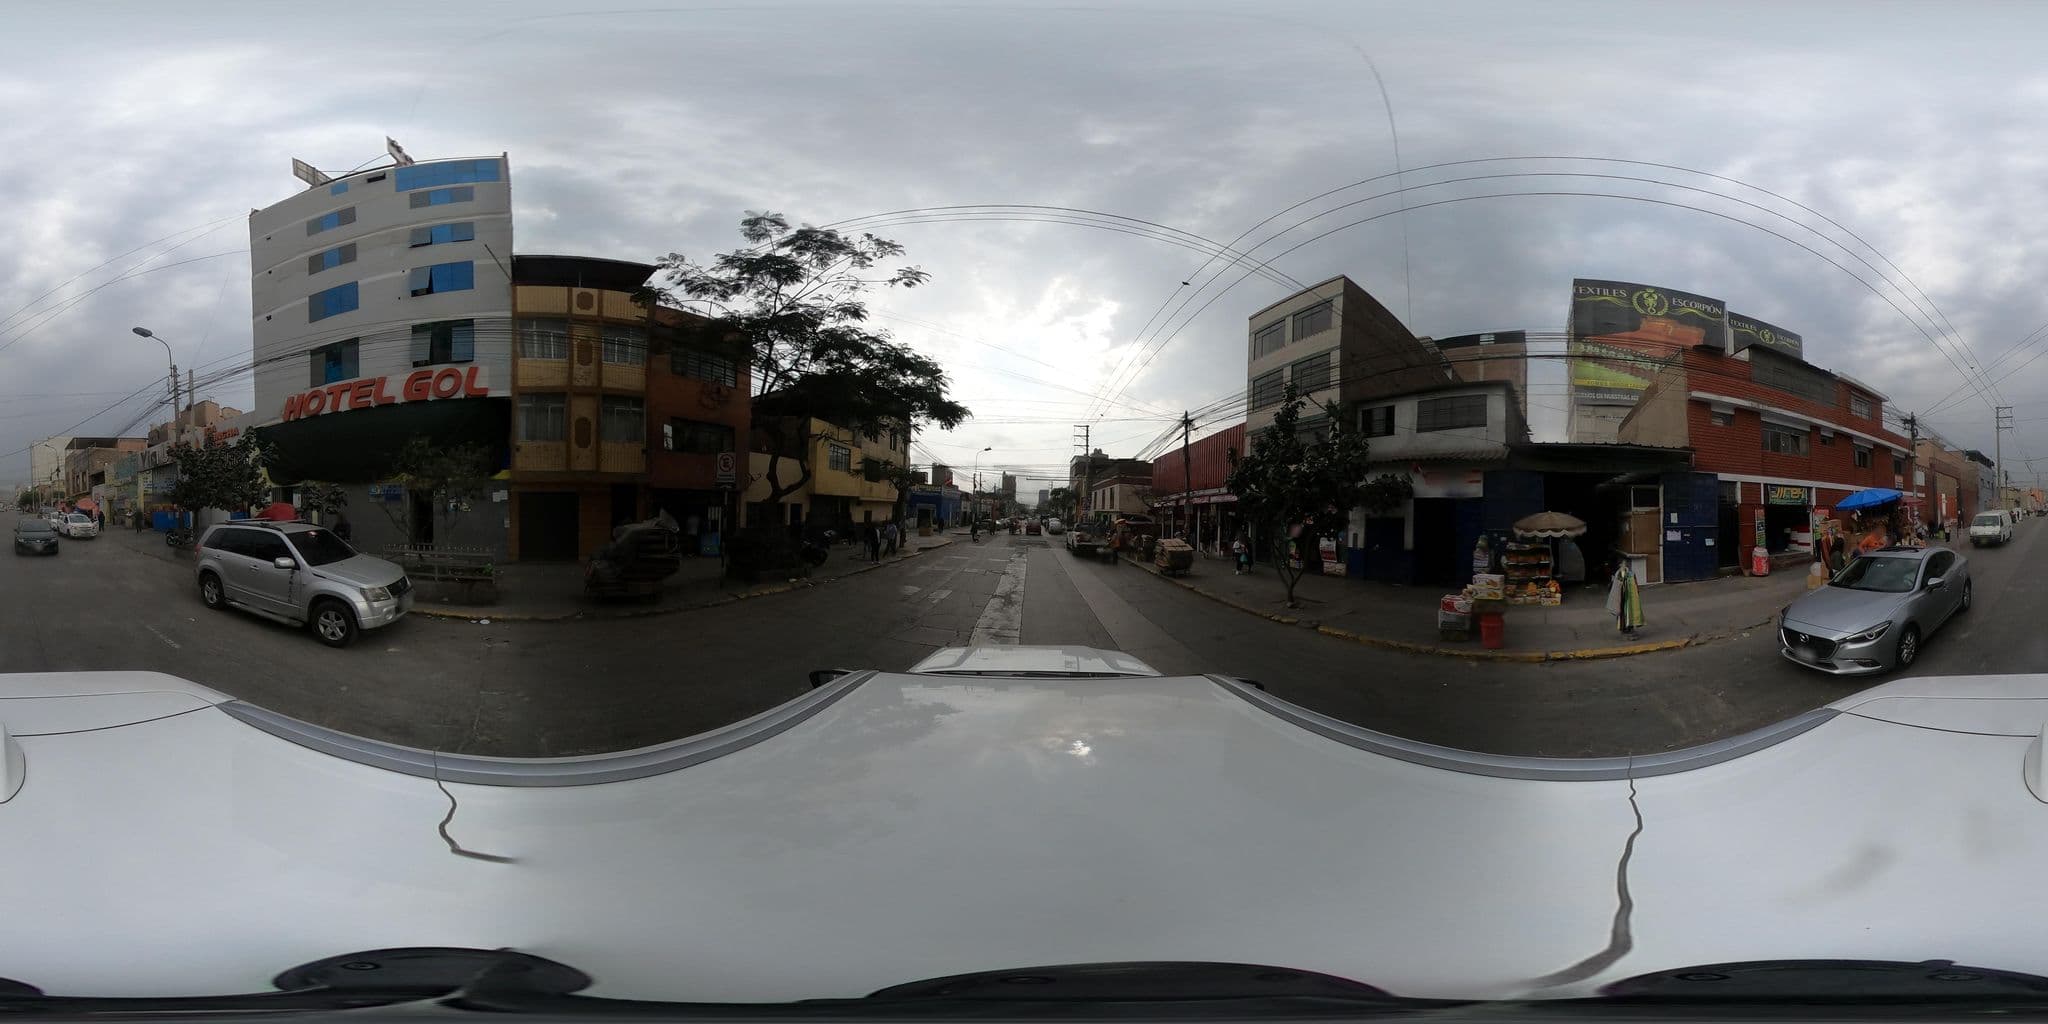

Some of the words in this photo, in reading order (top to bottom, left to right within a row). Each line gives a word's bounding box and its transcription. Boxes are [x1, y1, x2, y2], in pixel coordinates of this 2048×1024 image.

[1672, 296, 1723, 315] ESCORPIÓN
[282, 376, 396, 422] HOTEL
[403, 366, 489, 401] GOL
